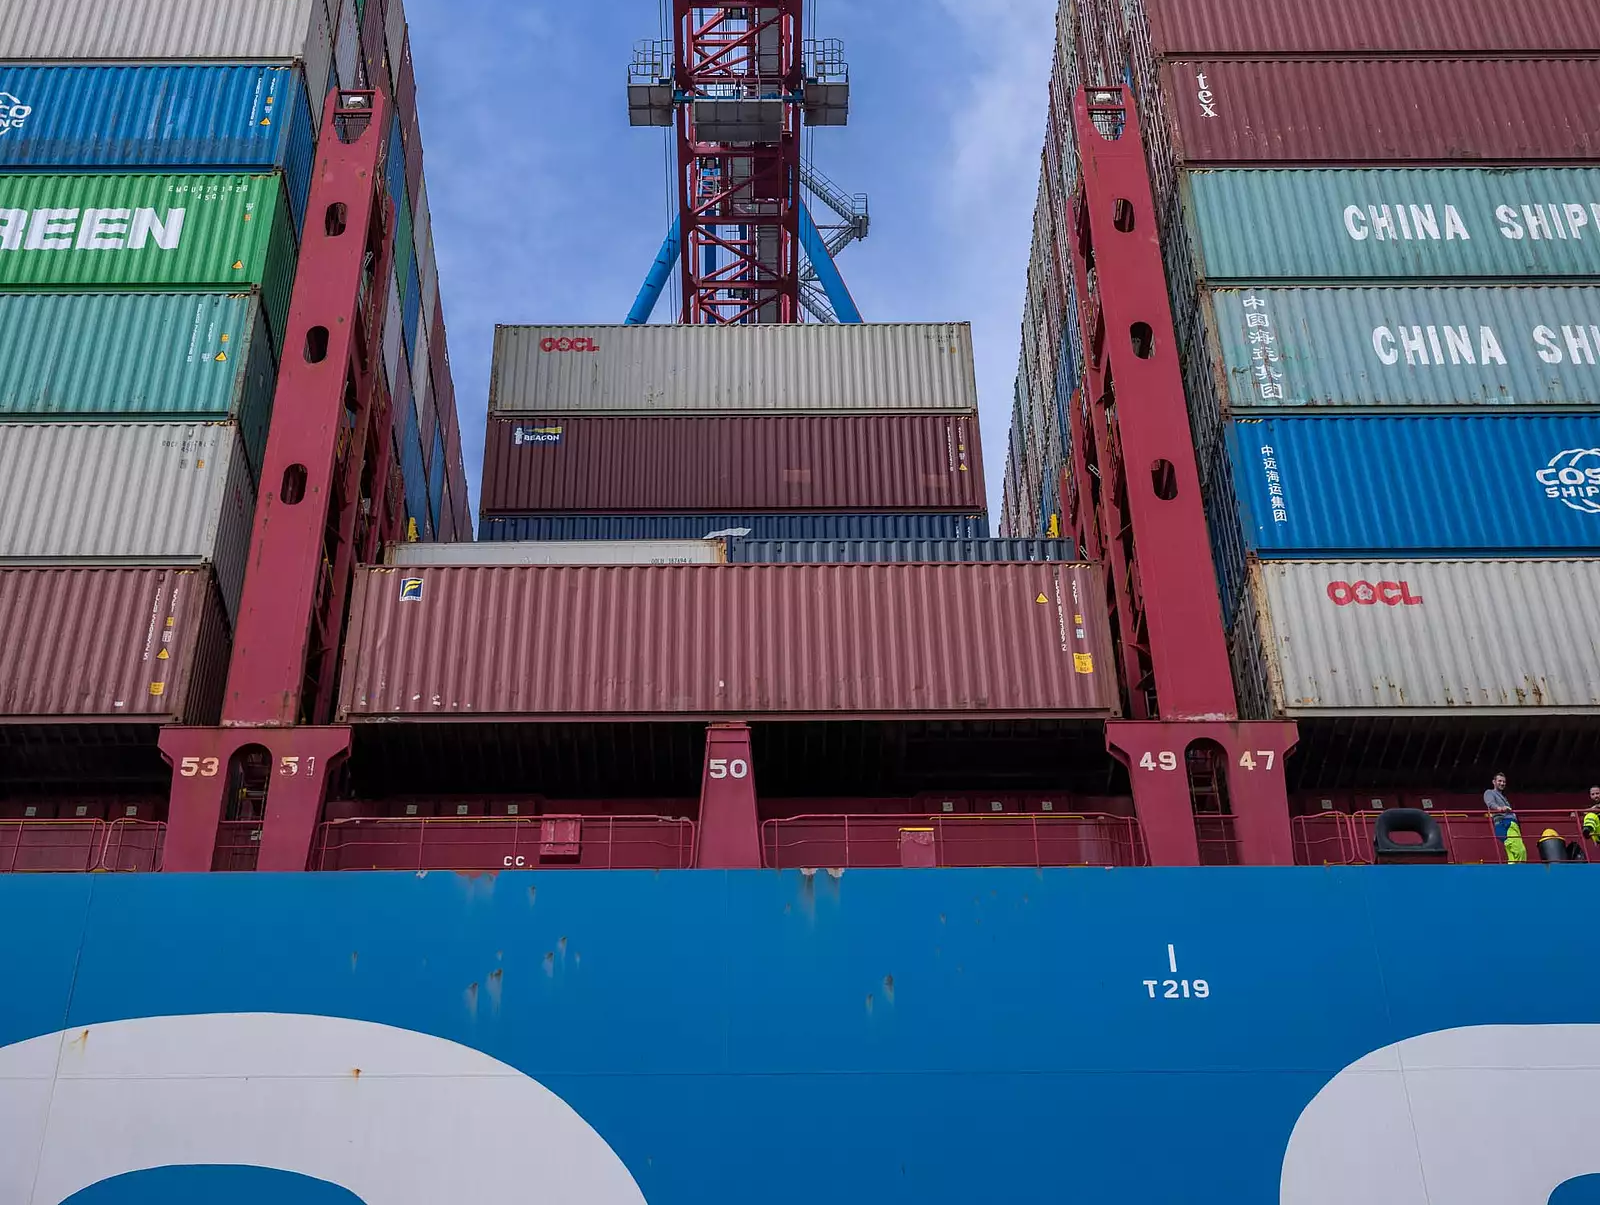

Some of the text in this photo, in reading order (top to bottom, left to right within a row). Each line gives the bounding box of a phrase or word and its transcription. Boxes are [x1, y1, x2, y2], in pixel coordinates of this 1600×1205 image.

[1343, 204, 1470, 241] CHINA
[540, 337, 600, 352] OOCL
[1372, 325, 1507, 365] CHINA
[1261, 444, 1287, 522] 中远海运集团
[1326, 580, 1423, 606] OOCL
[180, 756, 219, 777] 53
[279, 756, 316, 776] 51
[709, 758, 748, 779] 50
[1139, 751, 1177, 771] 49
[1239, 750, 1275, 771] 47
[1142, 979, 1210, 998] T219
